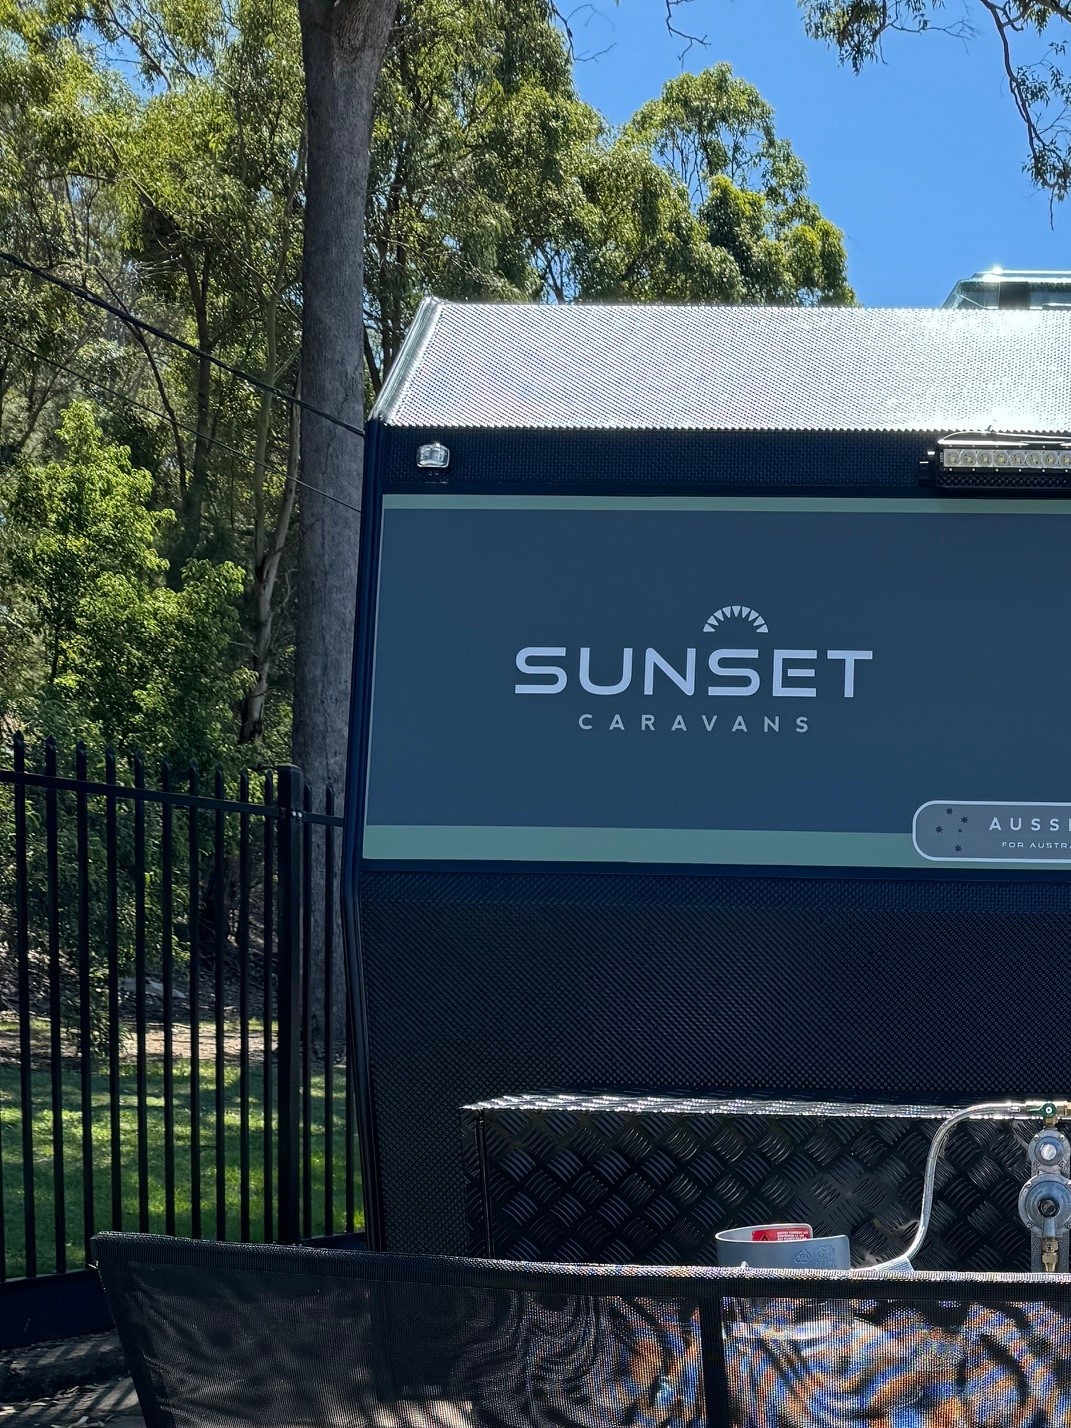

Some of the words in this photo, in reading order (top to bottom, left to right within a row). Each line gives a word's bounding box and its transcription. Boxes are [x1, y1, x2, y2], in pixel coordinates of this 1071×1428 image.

[514, 646, 874, 698] SUNSET
[578, 713, 809, 733] CARAVANS
[1001, 841, 1024, 849] FOR
